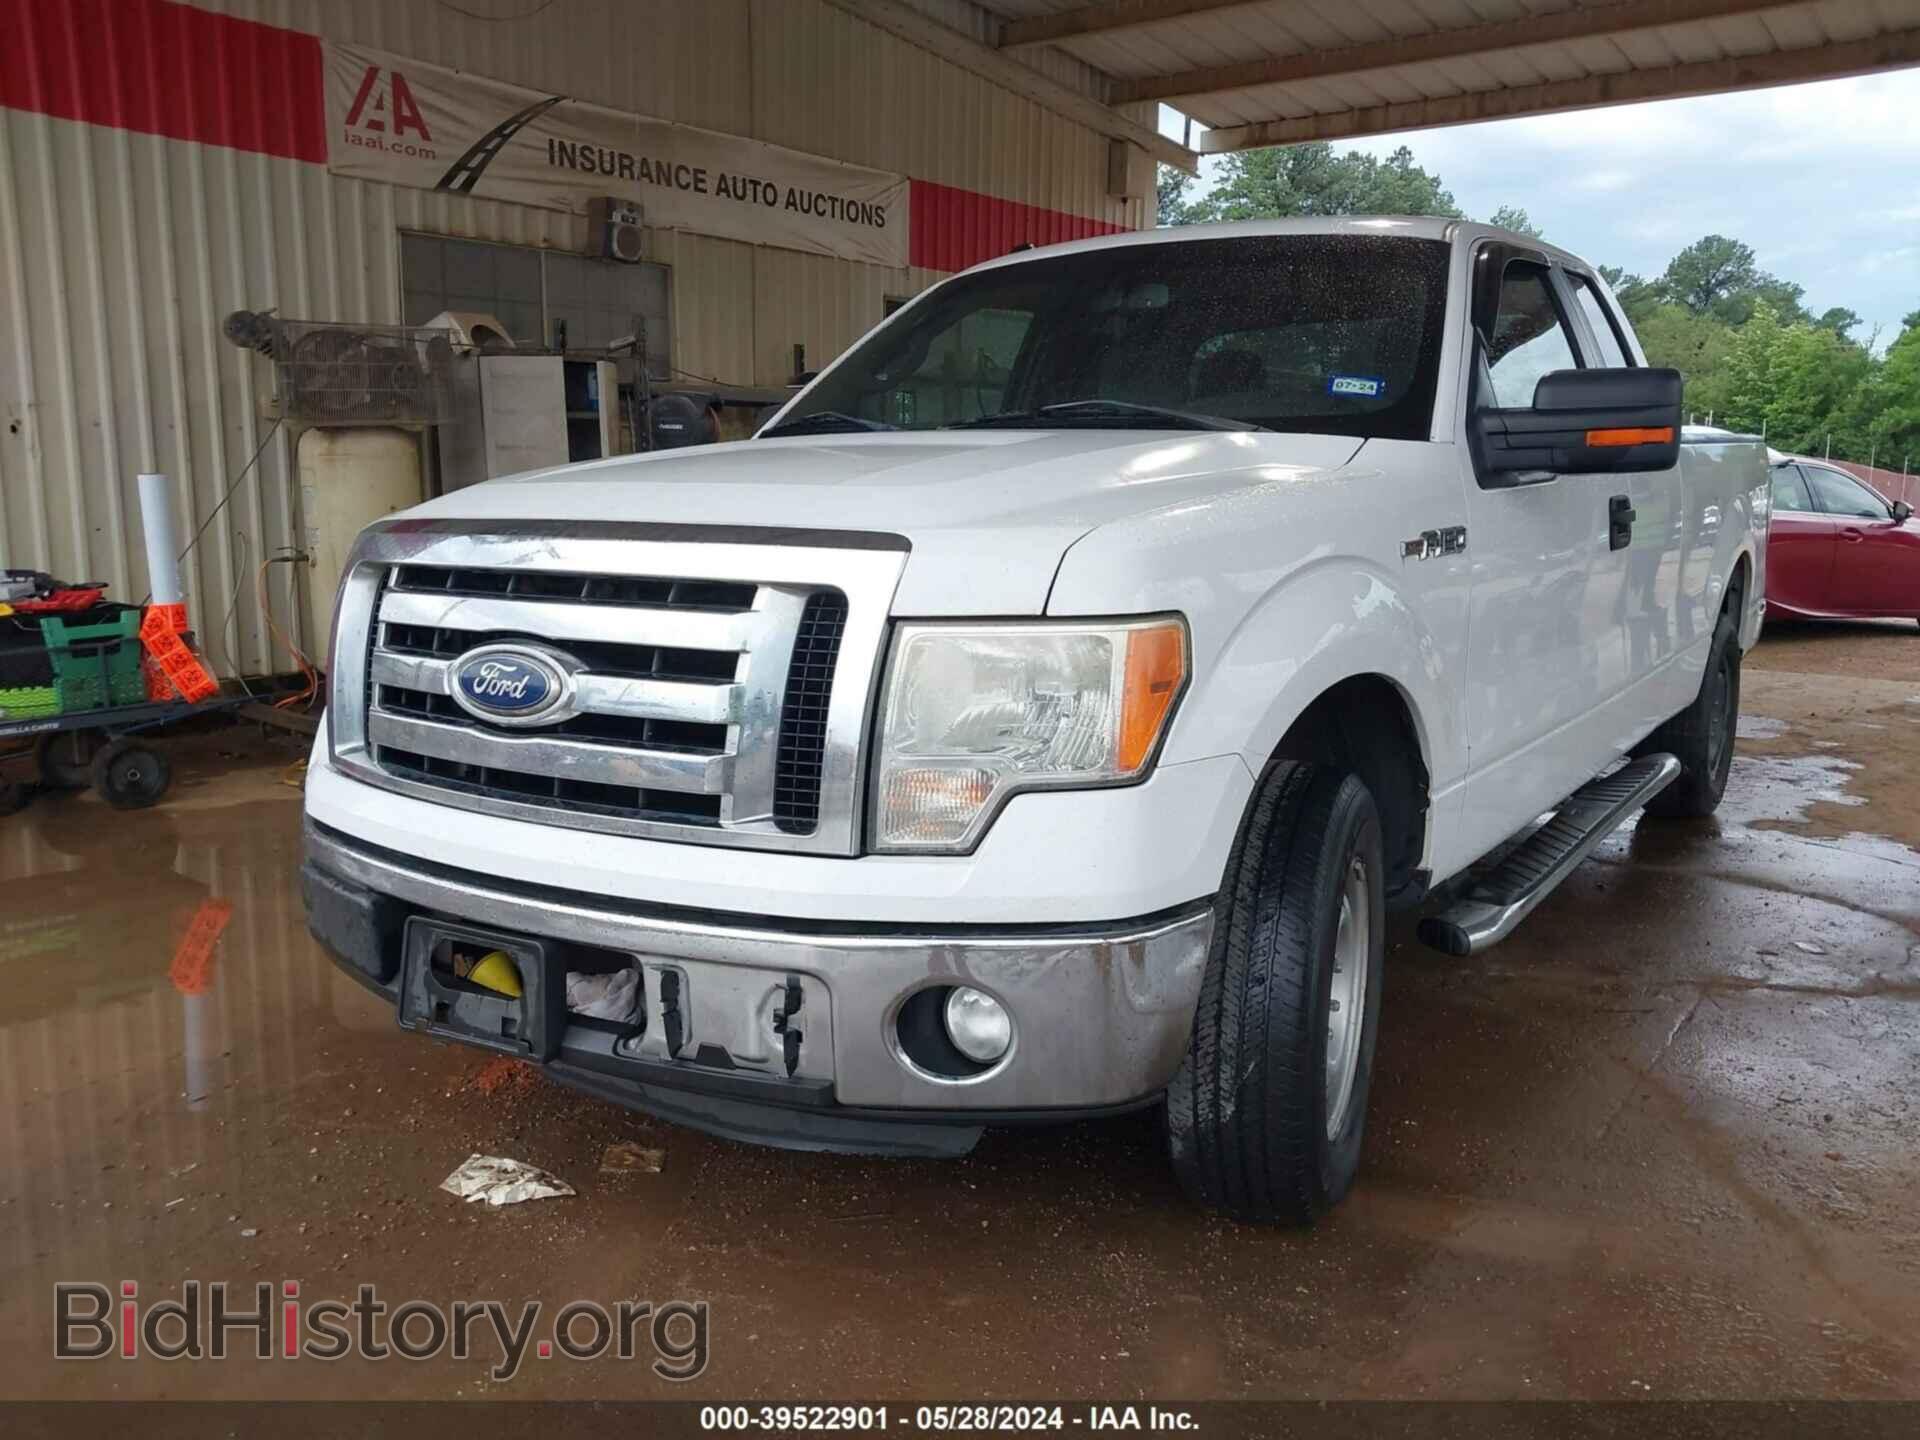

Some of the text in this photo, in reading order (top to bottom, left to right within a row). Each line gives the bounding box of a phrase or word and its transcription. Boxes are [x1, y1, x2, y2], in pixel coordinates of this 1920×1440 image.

[345, 66, 432, 141] IAA
[344, 128, 436, 160] iaai.com
[548, 138, 885, 228] INSURANCE AUTO AUCTIONS
[473, 662, 530, 699] Ford
